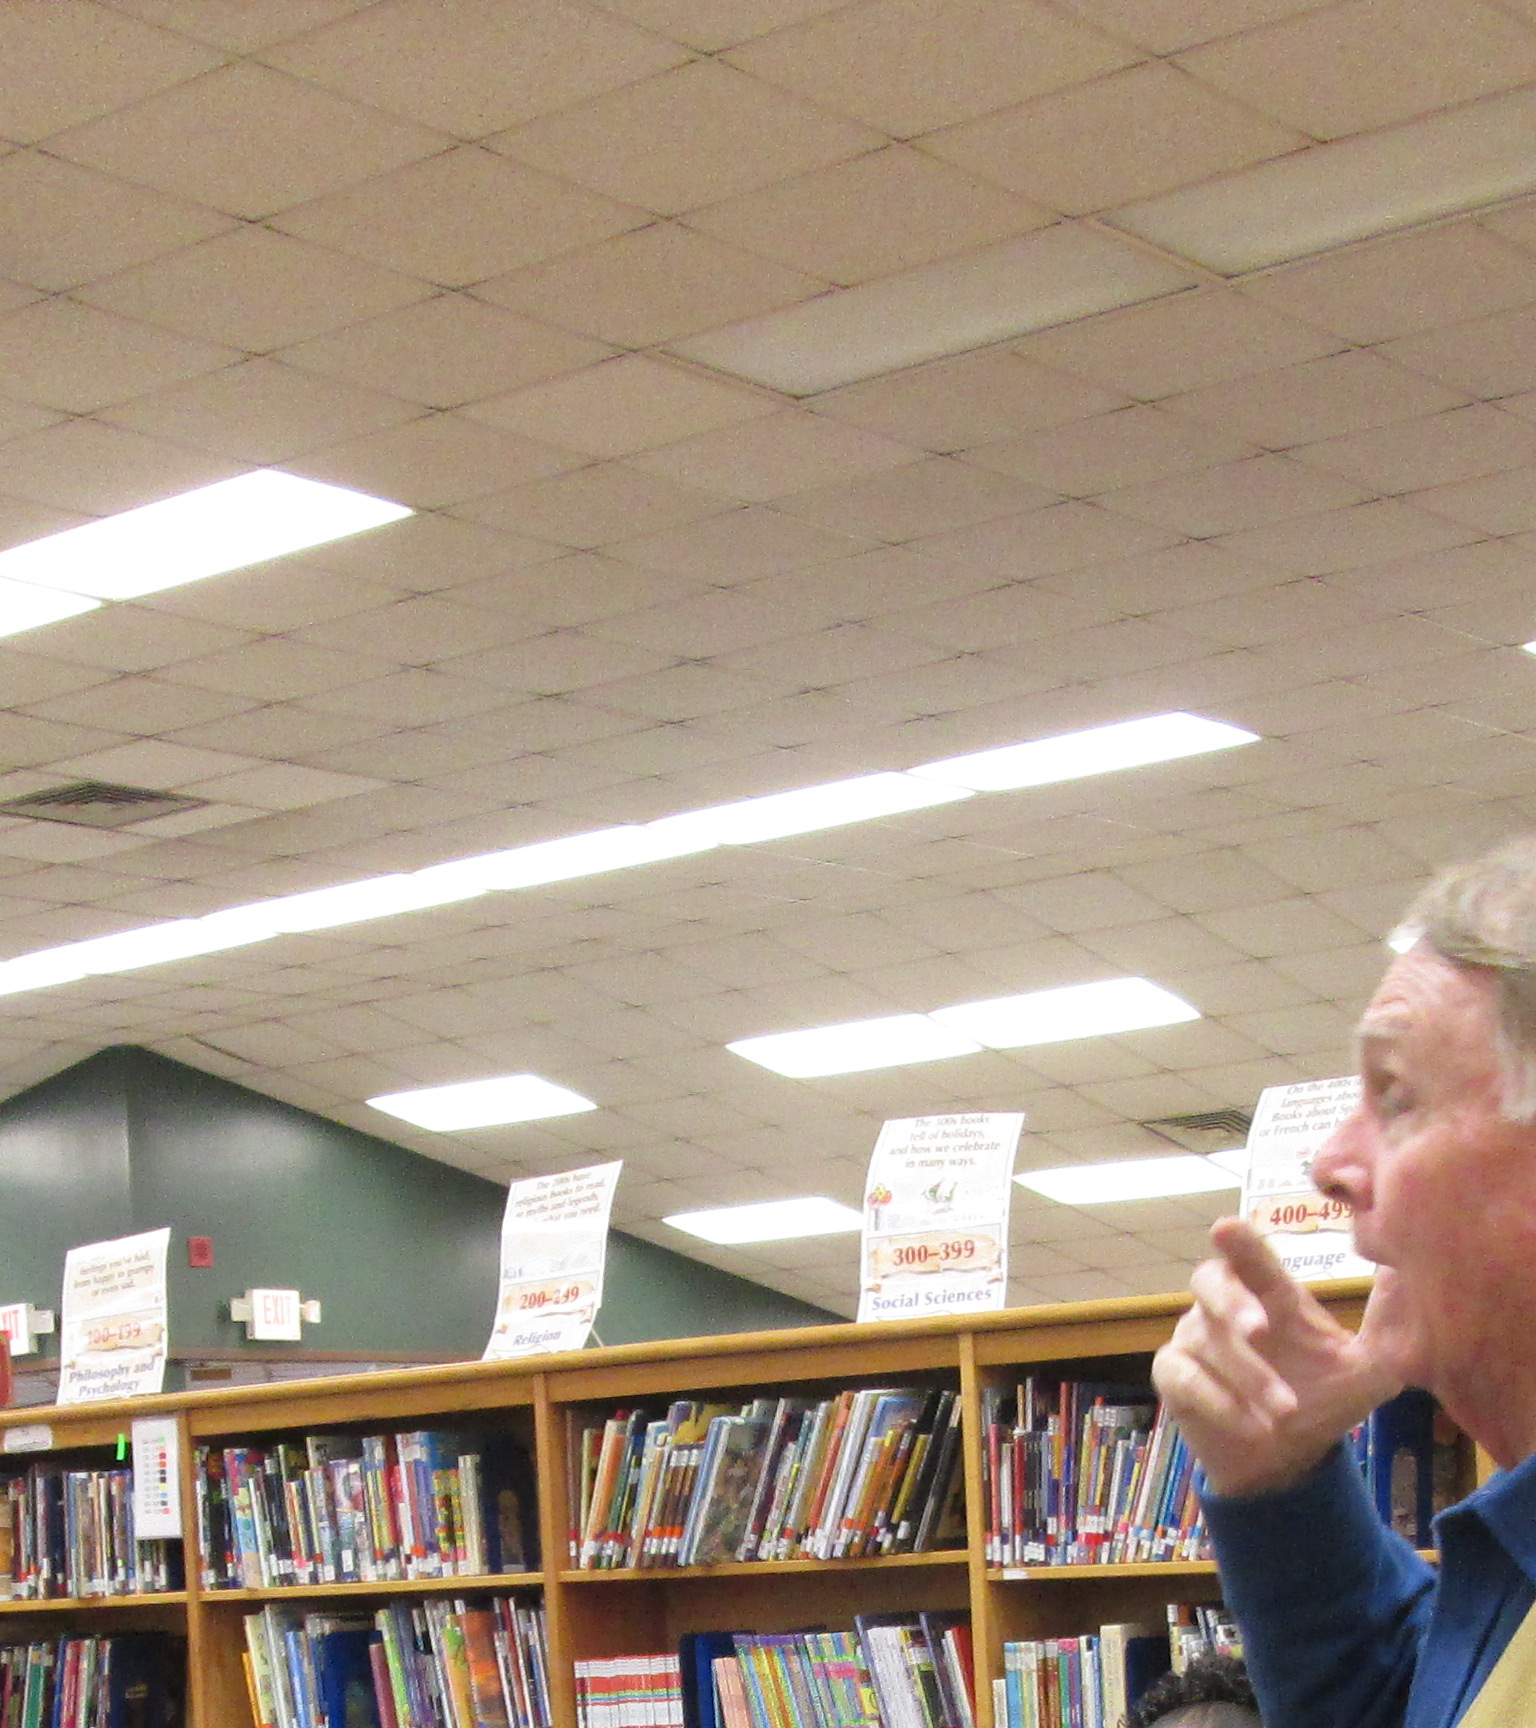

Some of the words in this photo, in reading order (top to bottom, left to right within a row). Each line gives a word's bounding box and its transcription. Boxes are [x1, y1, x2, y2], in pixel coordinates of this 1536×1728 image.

[953, 1141, 1001, 1152] celebrate
[918, 1159, 944, 1169] many
[1282, 1251, 1346, 1271] nguage
[872, 1292, 918, 1311] Social
[924, 1287, 992, 1305] Sciences
[263, 1295, 293, 1326] EXIT
[514, 1329, 562, 1347] Religion
[69, 1363, 130, 1384] Philosophy
[132, 1358, 155, 1372] and
[78, 1379, 140, 1397] Psychology
